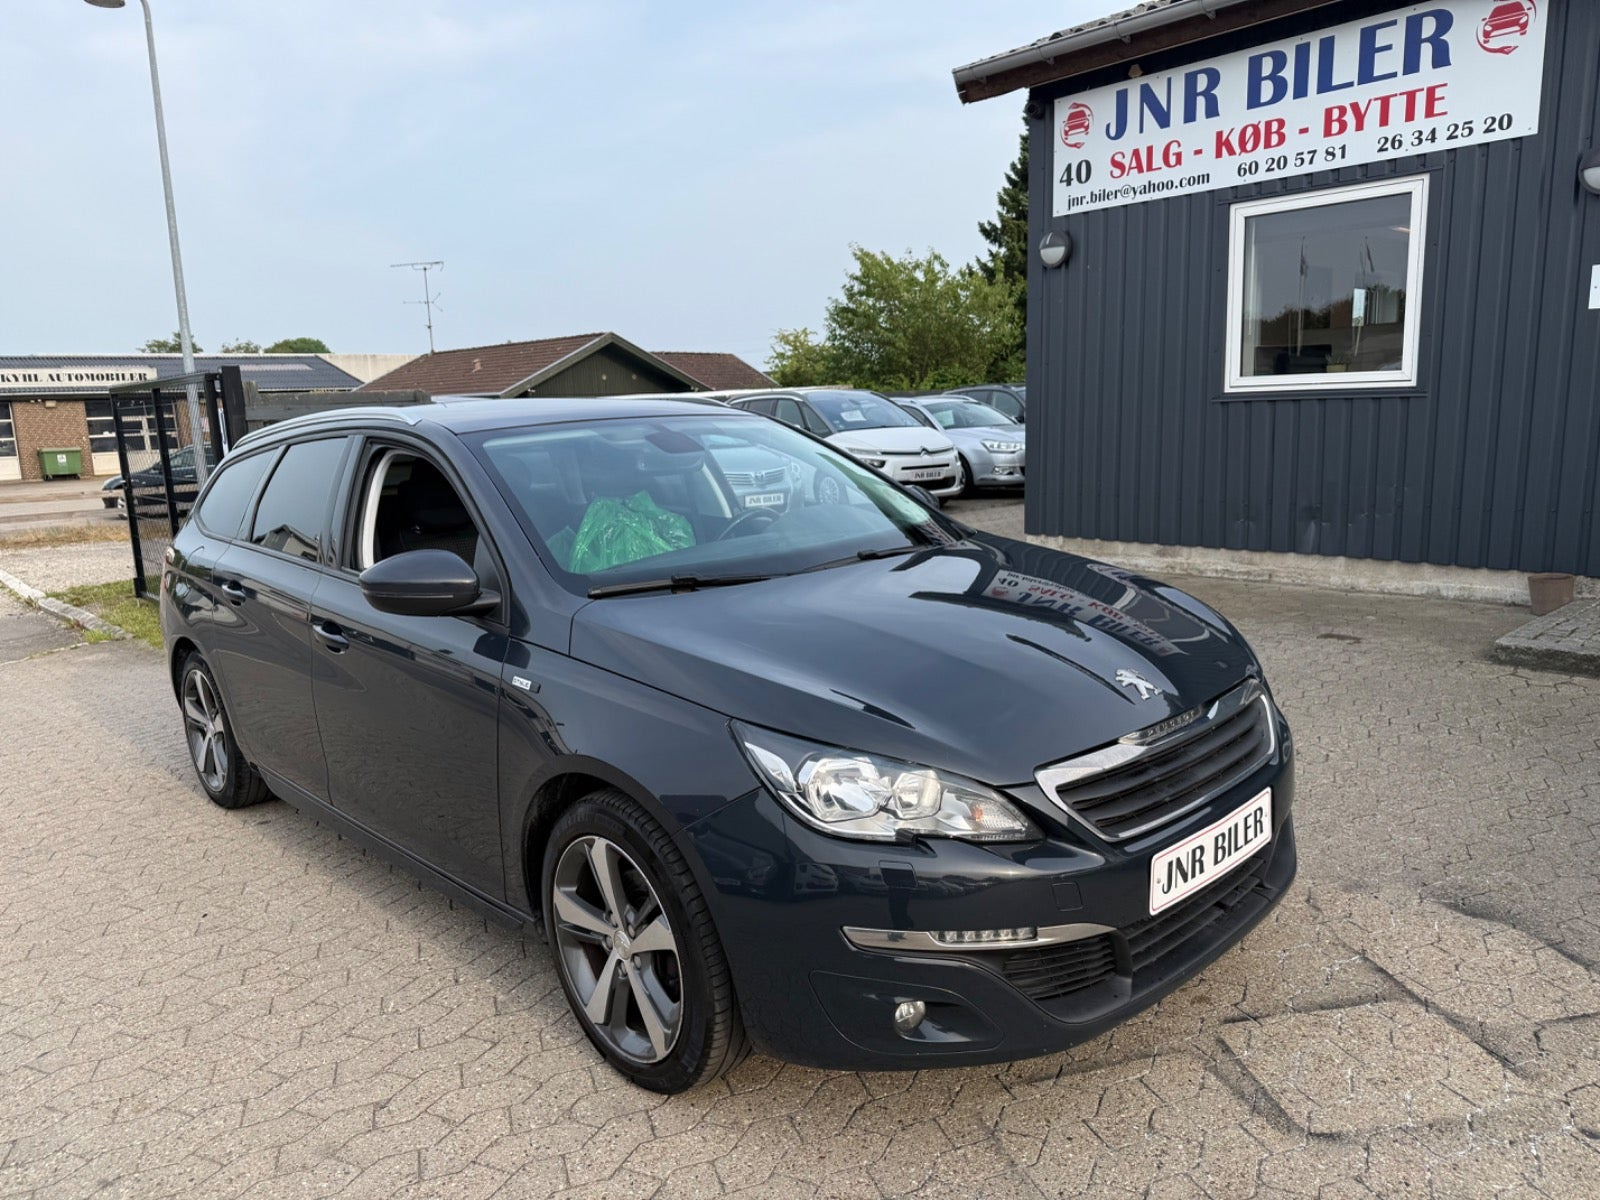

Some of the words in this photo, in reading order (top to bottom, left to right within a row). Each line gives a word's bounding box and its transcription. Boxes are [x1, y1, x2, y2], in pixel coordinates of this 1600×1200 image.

[1105, 67, 1221, 141] JNR
[1246, 8, 1454, 111] BILER
[1109, 139, 1183, 179] SALG
[1214, 117, 1286, 159] KØB
[1322, 83, 1448, 138] BYTTE
[1377, 133, 1403, 153] 26
[1411, 127, 1437, 147] 34
[1446, 120, 1474, 141] 25
[1483, 113, 1513, 134] 20
[1059, 159, 1092, 187] 40
[1237, 160, 1259, 178] 60
[1265, 155, 1288, 173] 20
[1294, 149, 1318, 168] 57
[1324, 144, 1347, 162] 81
[1067, 173, 1210, 210] jnr.biler@yahoo.com
[46, 372, 148, 383] AUTOMOBILER
[1161, 844, 1205, 895] JNR
[1213, 806, 1264, 867] BILER
